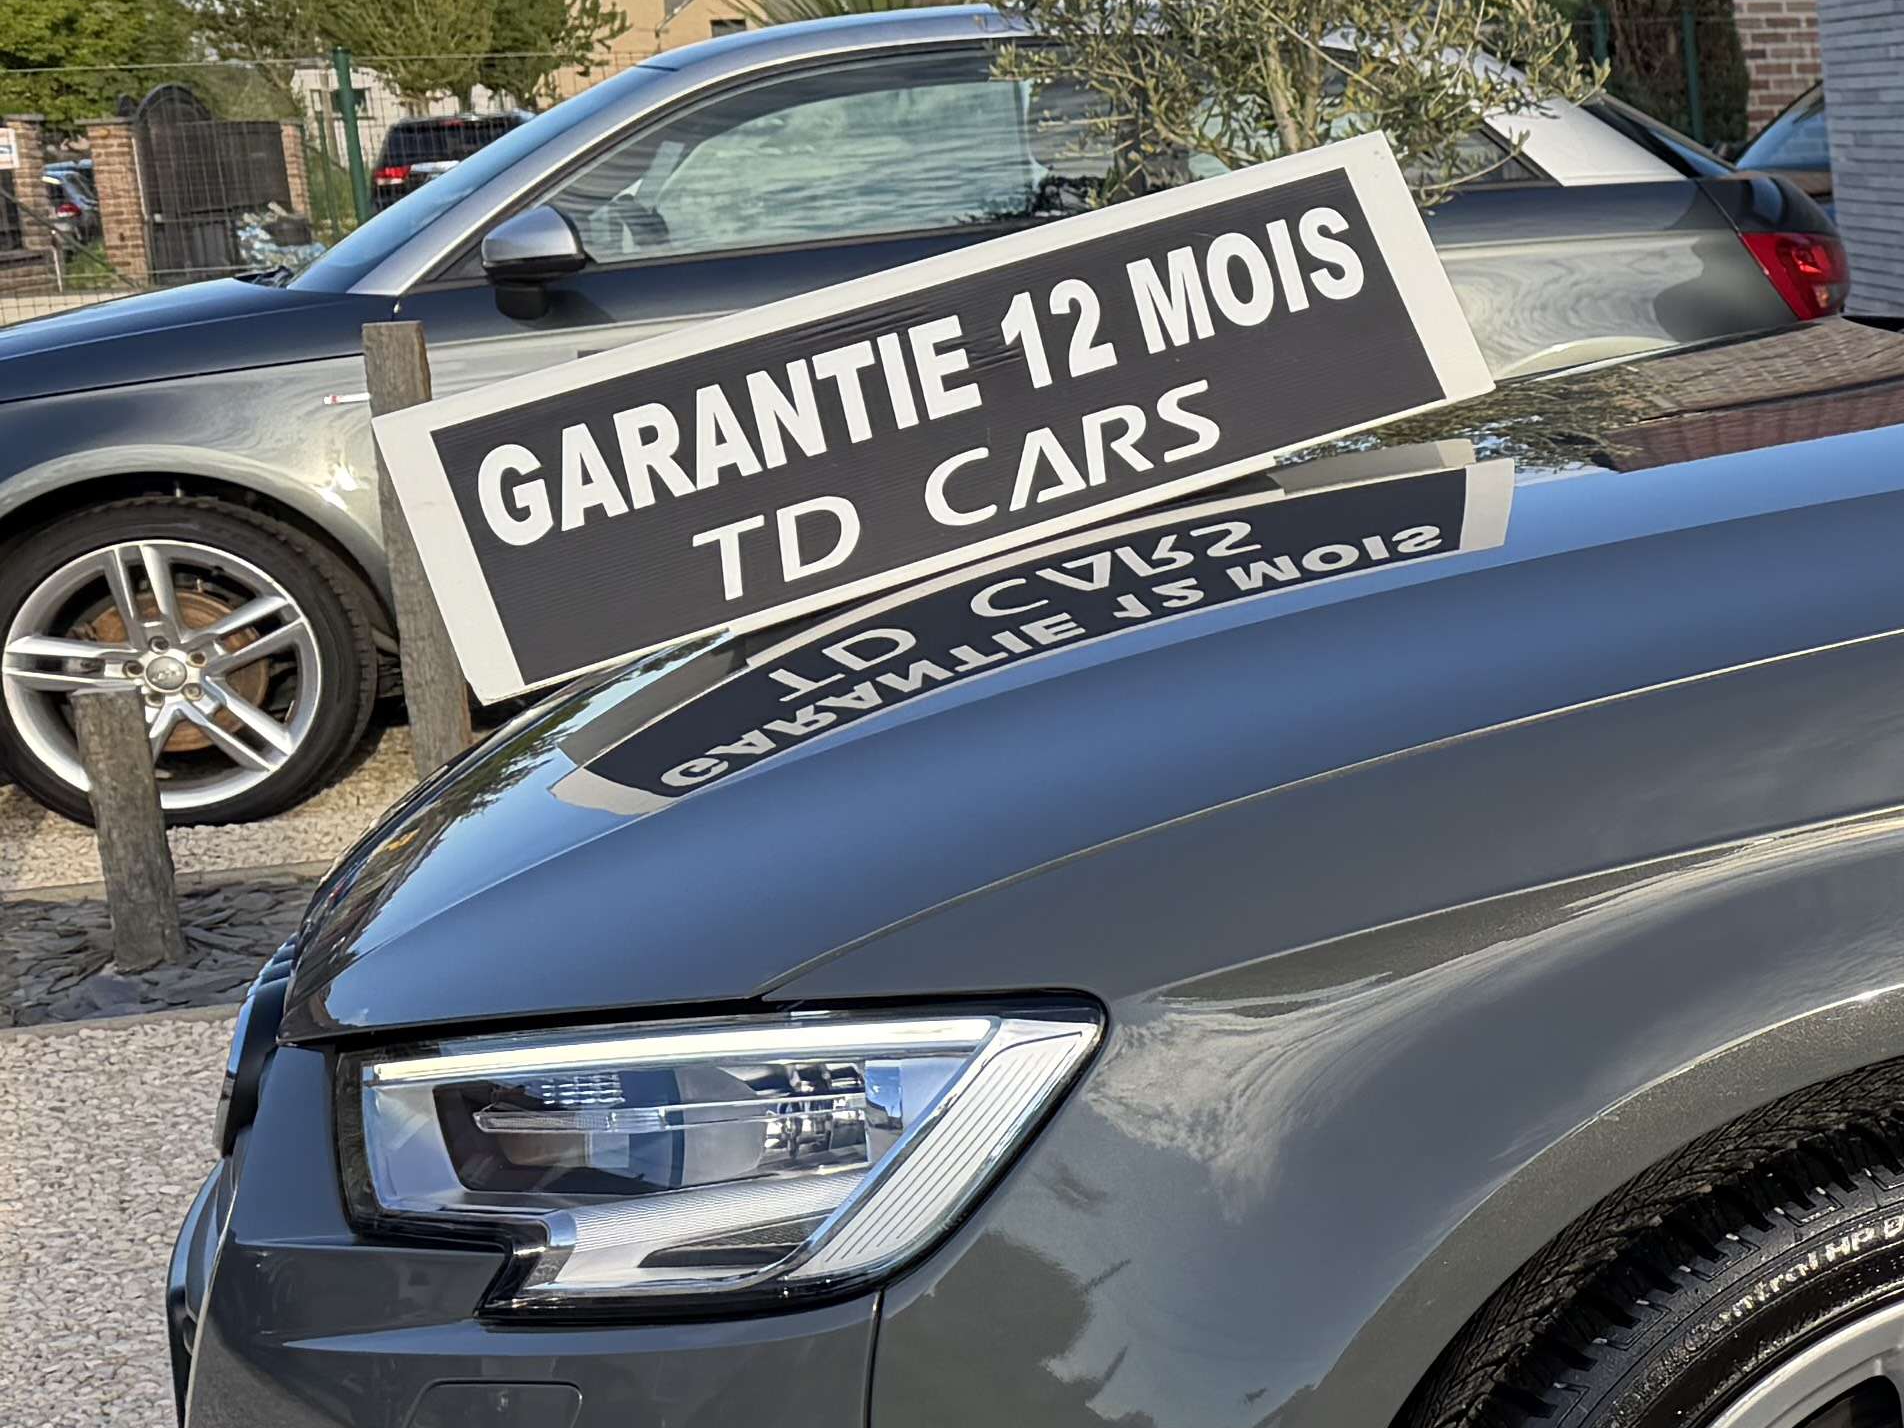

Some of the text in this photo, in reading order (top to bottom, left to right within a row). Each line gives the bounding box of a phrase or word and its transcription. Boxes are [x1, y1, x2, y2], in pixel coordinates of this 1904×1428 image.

[477, 206, 1366, 546] GARANTIE 12 MOIS
[692, 379, 1222, 602] TD CARS
